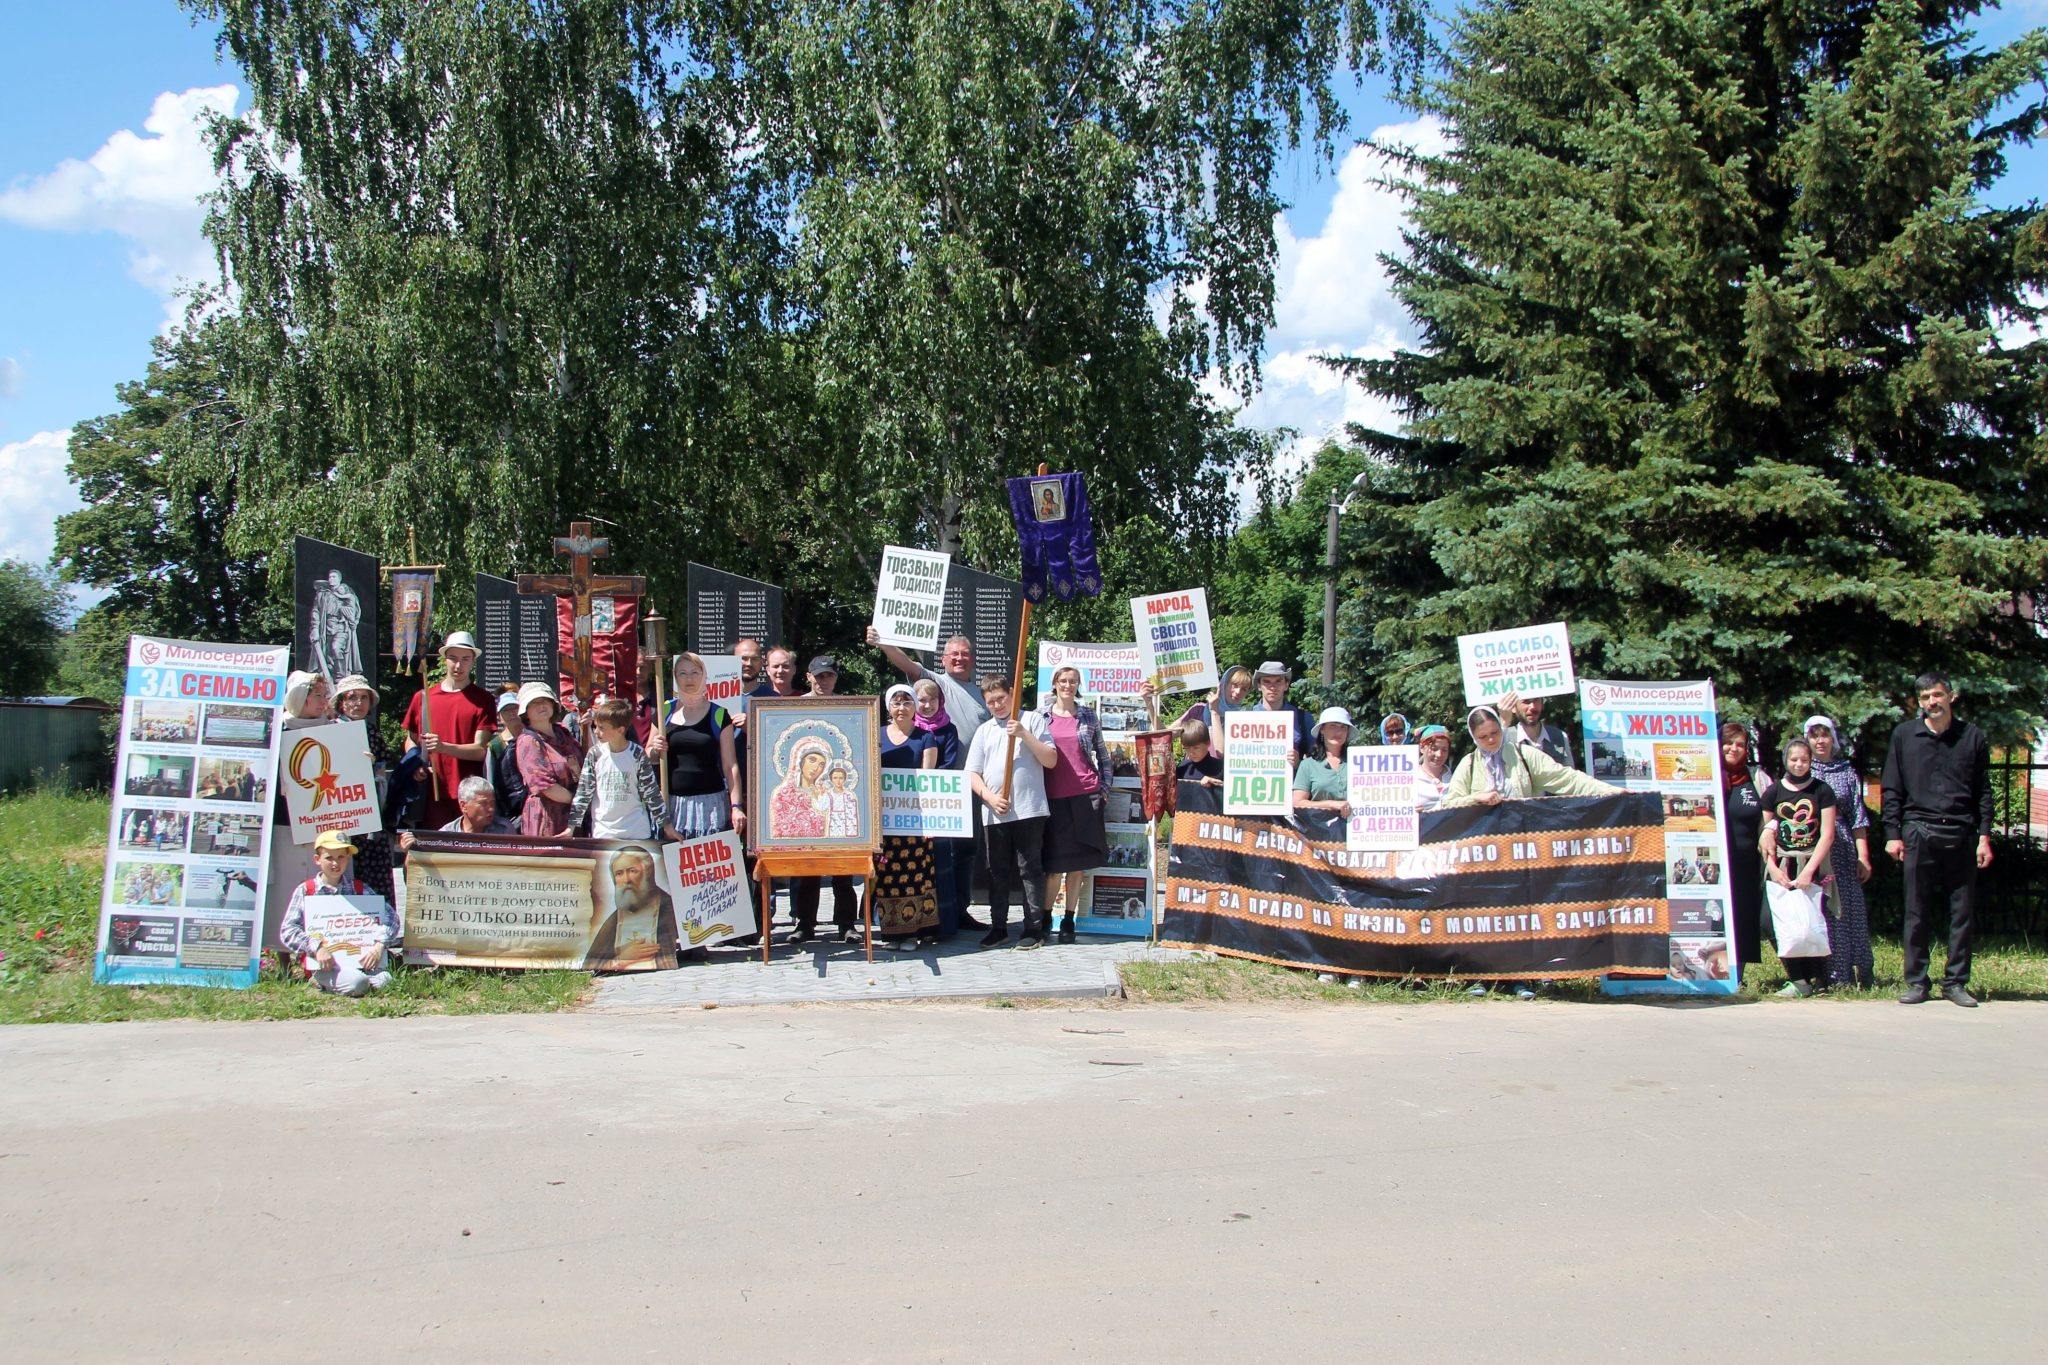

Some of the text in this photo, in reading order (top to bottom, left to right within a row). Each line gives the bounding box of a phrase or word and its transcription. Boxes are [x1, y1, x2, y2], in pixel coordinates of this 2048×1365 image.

[1146, 595, 1194, 615] НАРОД,
[1151, 621, 1197, 640] СВОЕГО
[1153, 637, 1200, 653] ПРОШЛОГО,
[1474, 635, 1559, 658] СПАСИБО,
[165, 644, 275, 665] Милосердие
[1155, 653, 1168, 666] НЕ
[1169, 649, 1201, 663] ИМЕЕТ
[1500, 652, 1559, 665] ПОДАРИЛИ
[1089, 669, 1142, 680] ТРЕЗВУЮ
[1157, 661, 1204, 679] БУДУЩЕГО
[1505, 665, 1535, 675] НАМ
[140, 668, 277, 701] ЗА СЕМЬЮ
[1088, 681, 1140, 693] РОССИЮ
[1480, 671, 1563, 696] ЖИЗНЬ!
[1610, 687, 1702, 701] Милосердие
[1591, 711, 1709, 738] ЗА ЖИЗНЬ
[1230, 744, 1286, 756] единство
[1353, 754, 1413, 773] ЧТИТЬ
[881, 773, 961, 793] СЧАСТЬЕ
[326, 784, 366, 805] МАЯ
[882, 797, 962, 810] нуждается
[1352, 805, 1413, 816] заботиться
[316, 819, 359, 833] ПОБЕДЫ!
[882, 815, 962, 829] В ВЕРНОСТИ
[1198, 822, 1244, 844] НАШИ
[1255, 830, 1303, 855] ДЕДЫ
[679, 840, 731, 873] ДЕНЬ
[1512, 842, 1538, 860] НА
[1552, 836, 1631, 858] ЖИЗНЬ!
[681, 863, 735, 887] ПОБЕДЫ
[450, 880, 475, 889] ВАМ
[478, 880, 503, 890] МОЁ
[505, 882, 580, 892] ЗАВЕЩАНИЕ:
[692, 879, 728, 905] РАДОСТЬ
[418, 894, 579, 909] НЕ ИМЕЙТЕ В ДОМУ СВОЁМ
[685, 882, 739, 921] СО СЛЕЗАМИ
[707, 896, 737, 920] ГЛАЗАХ
[1178, 886, 1654, 934] МЫ ЗА ПРАВО НА ЖИЗНЬ С МОМЕНТА ЗАЧАТИЯ!
[327, 917, 381, 930] ПОБЕДА
[420, 909, 576, 926] НЕ ТОЛЬКО ВИНА,
[413, 926, 429, 934] НО
[430, 927, 460, 936] ДАЖЕ
[472, 928, 529, 938] ПОСУДИНЫ
